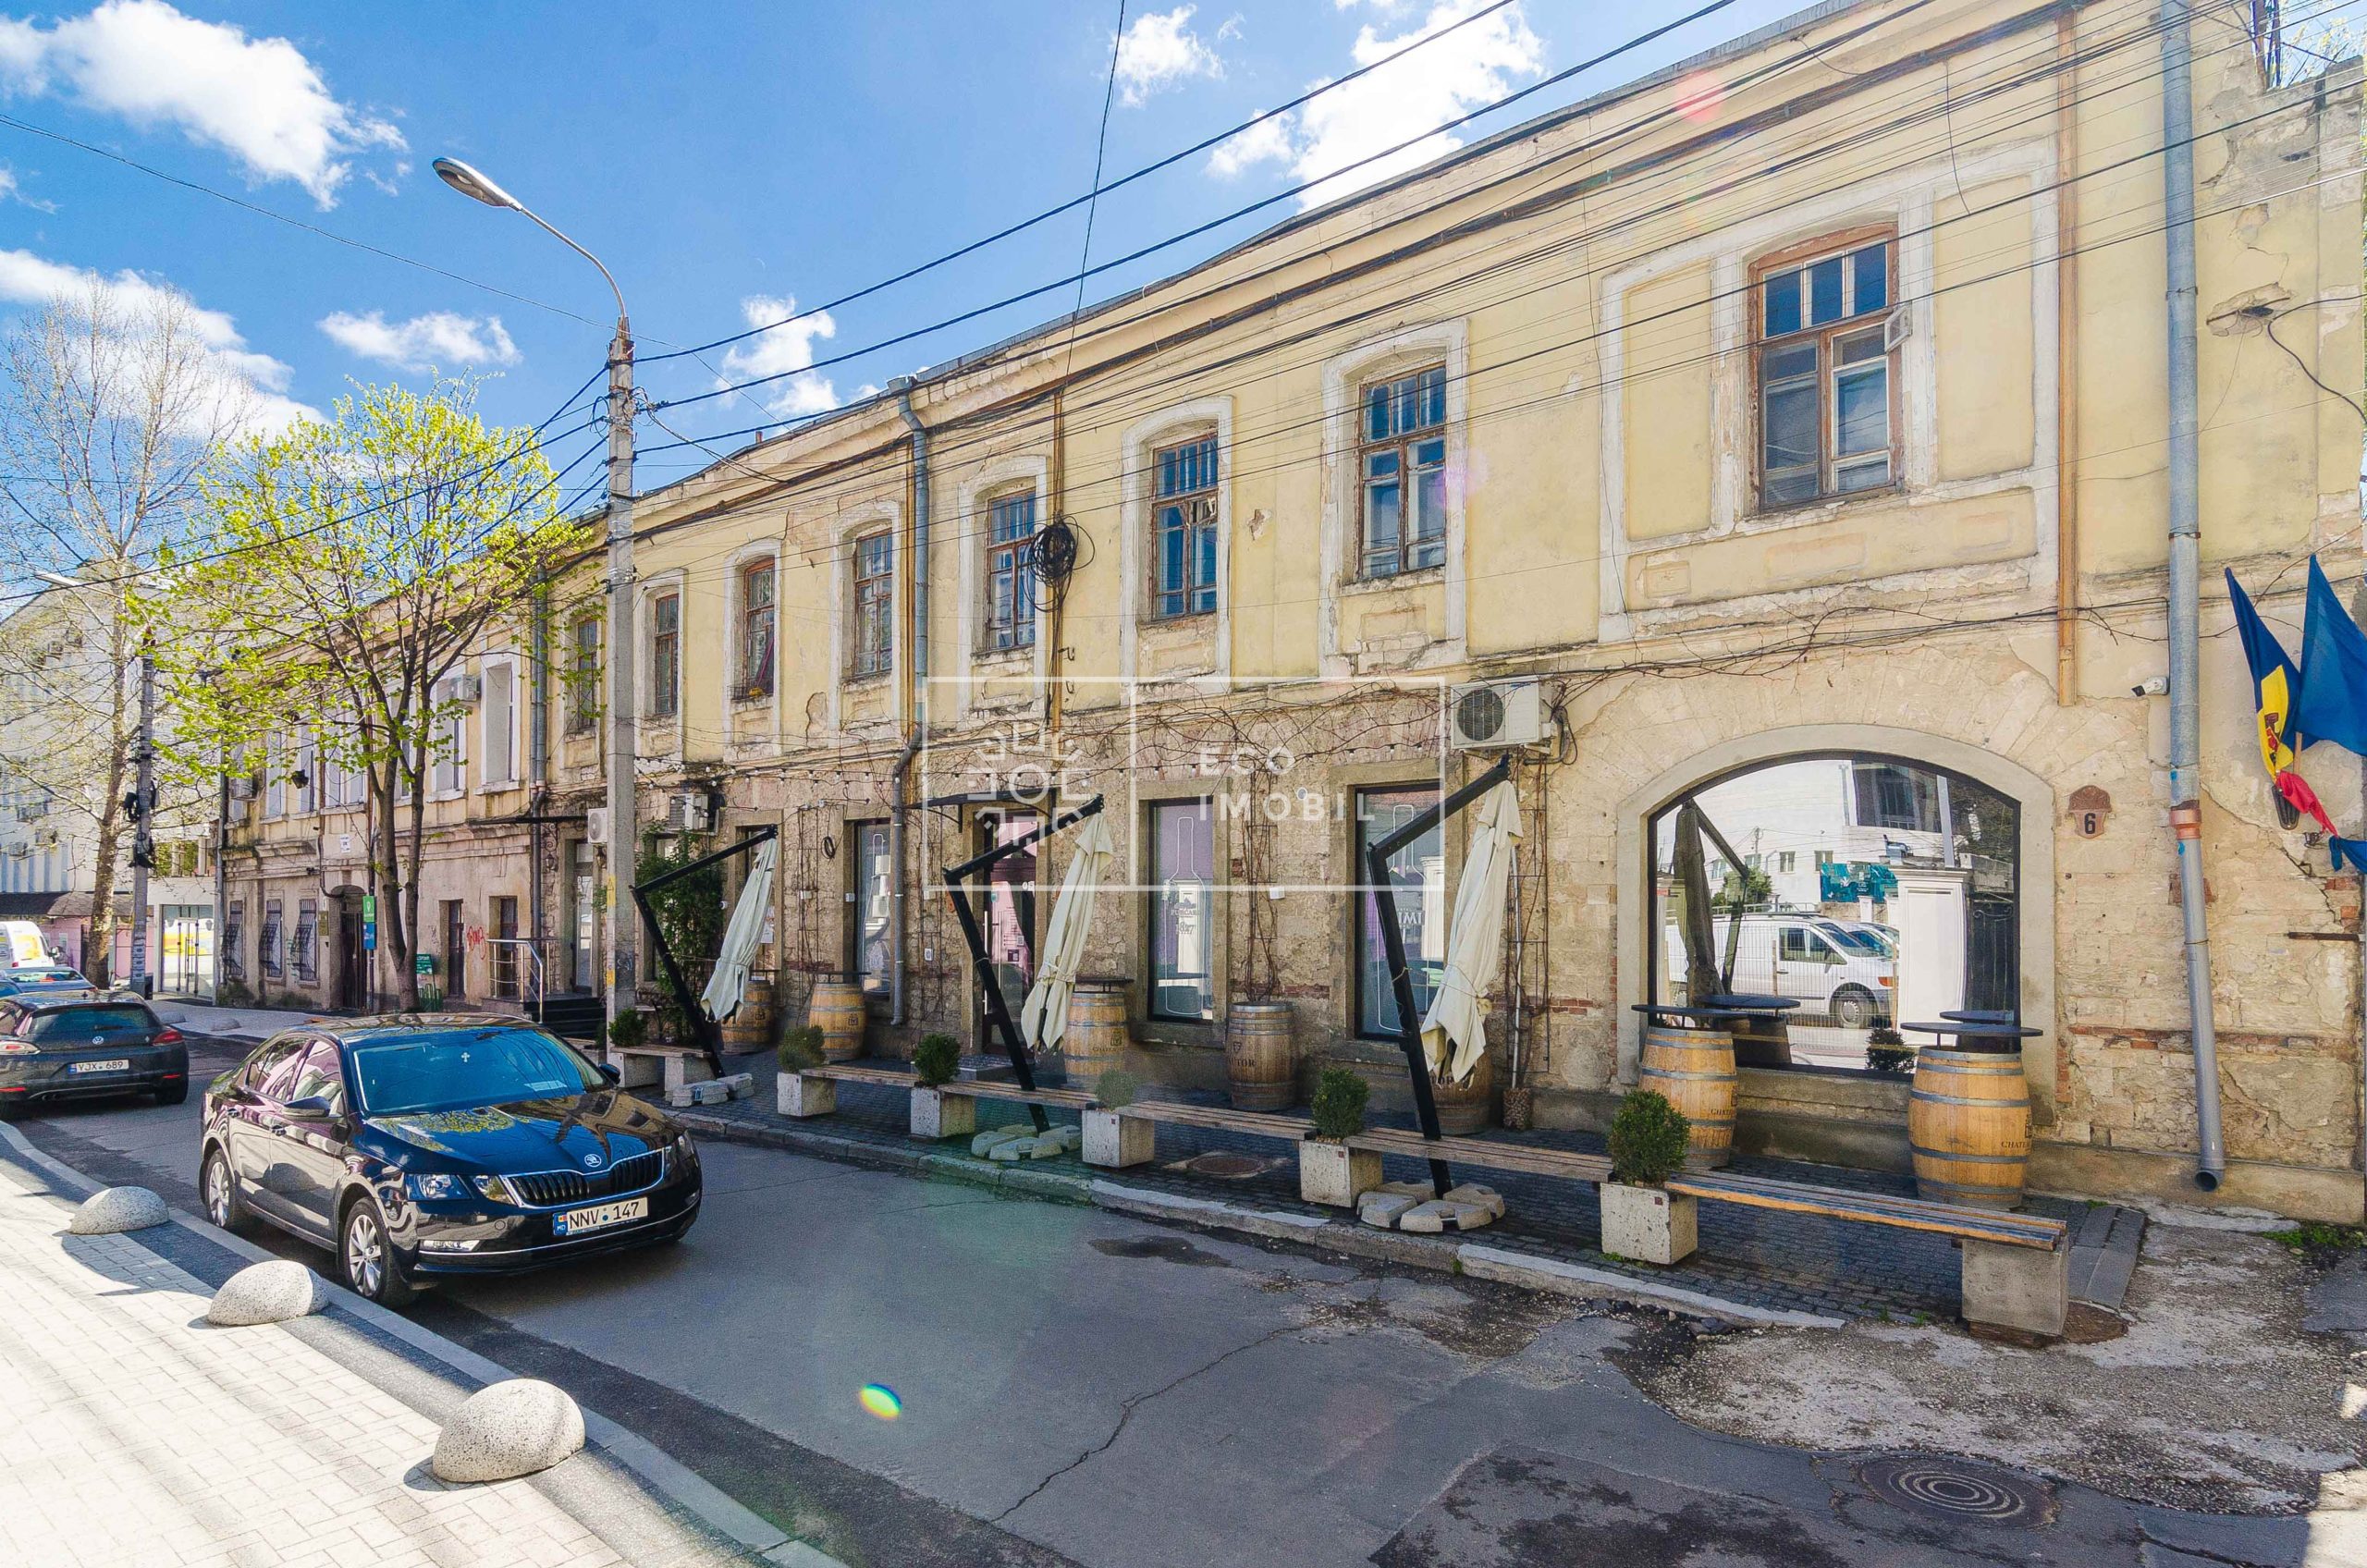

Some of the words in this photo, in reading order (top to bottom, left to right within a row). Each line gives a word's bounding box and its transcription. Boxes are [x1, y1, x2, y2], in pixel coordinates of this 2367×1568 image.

[2084, 813, 2096, 835] 6
[105, 1060, 124, 1070] 689
[569, 1209, 600, 1230] NNV
[612, 1201, 640, 1220] 147
